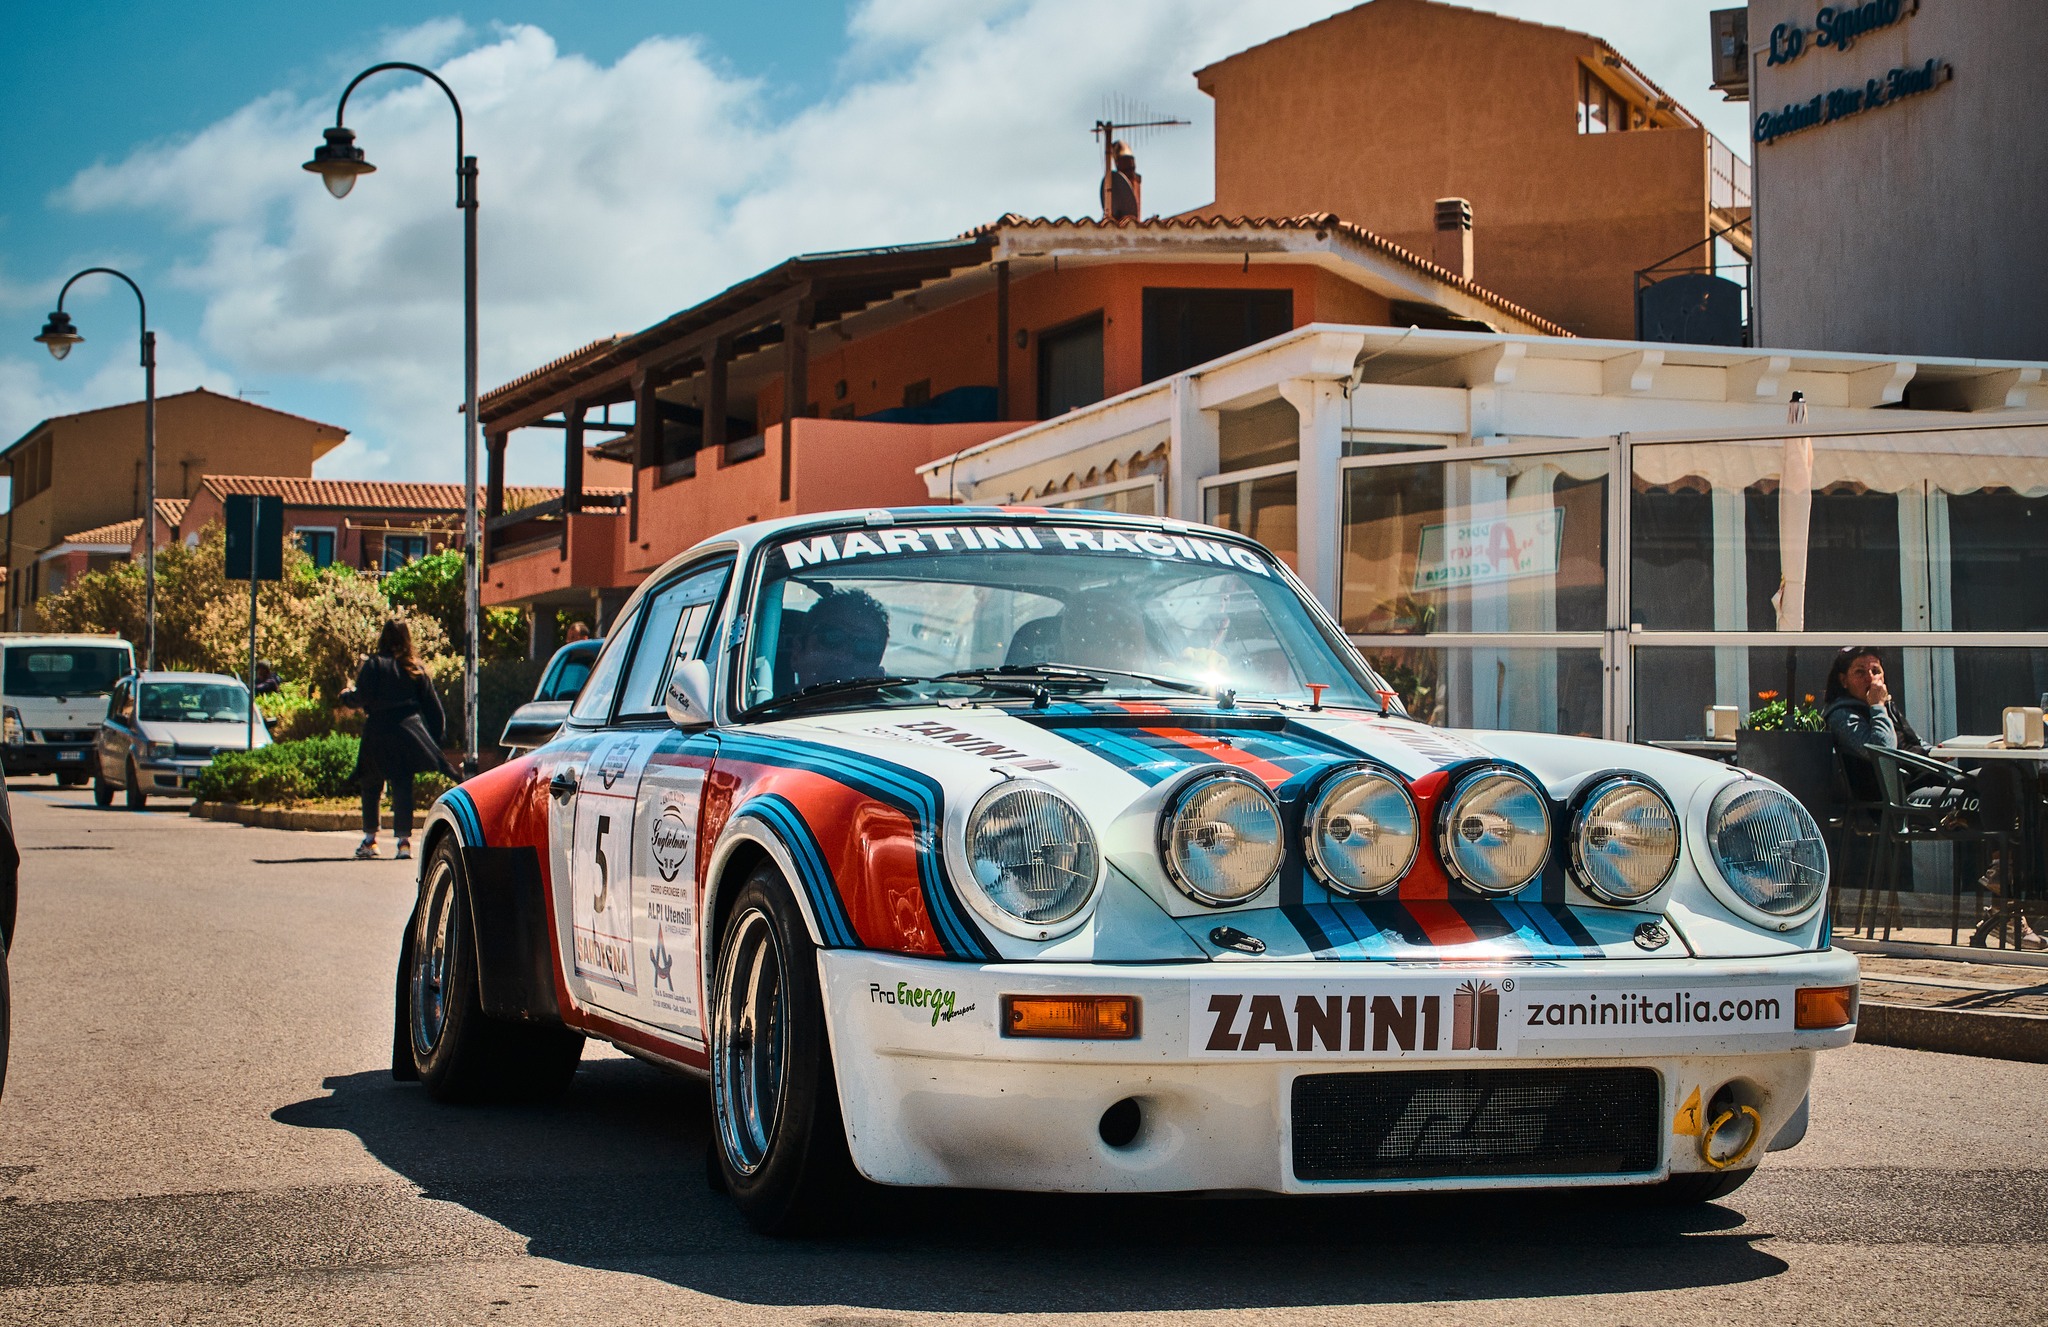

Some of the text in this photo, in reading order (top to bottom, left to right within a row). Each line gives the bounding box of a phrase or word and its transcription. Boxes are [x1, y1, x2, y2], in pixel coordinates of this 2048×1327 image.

[1767, 23, 1803, 67] Lo
[1754, 94, 1822, 143] Cocktail
[1827, 88, 1863, 121] Bar
[1887, 58, 1935, 99] Food
[781, 526, 1271, 578] MARTINI RACING
[894, 721, 1028, 760] ZANINI
[594, 815, 610, 913] 5
[648, 902, 692, 926] ALPI Utensili
[1205, 994, 1441, 1051] ZANINI
[1527, 993, 1780, 1026] zaniniitalia.com
